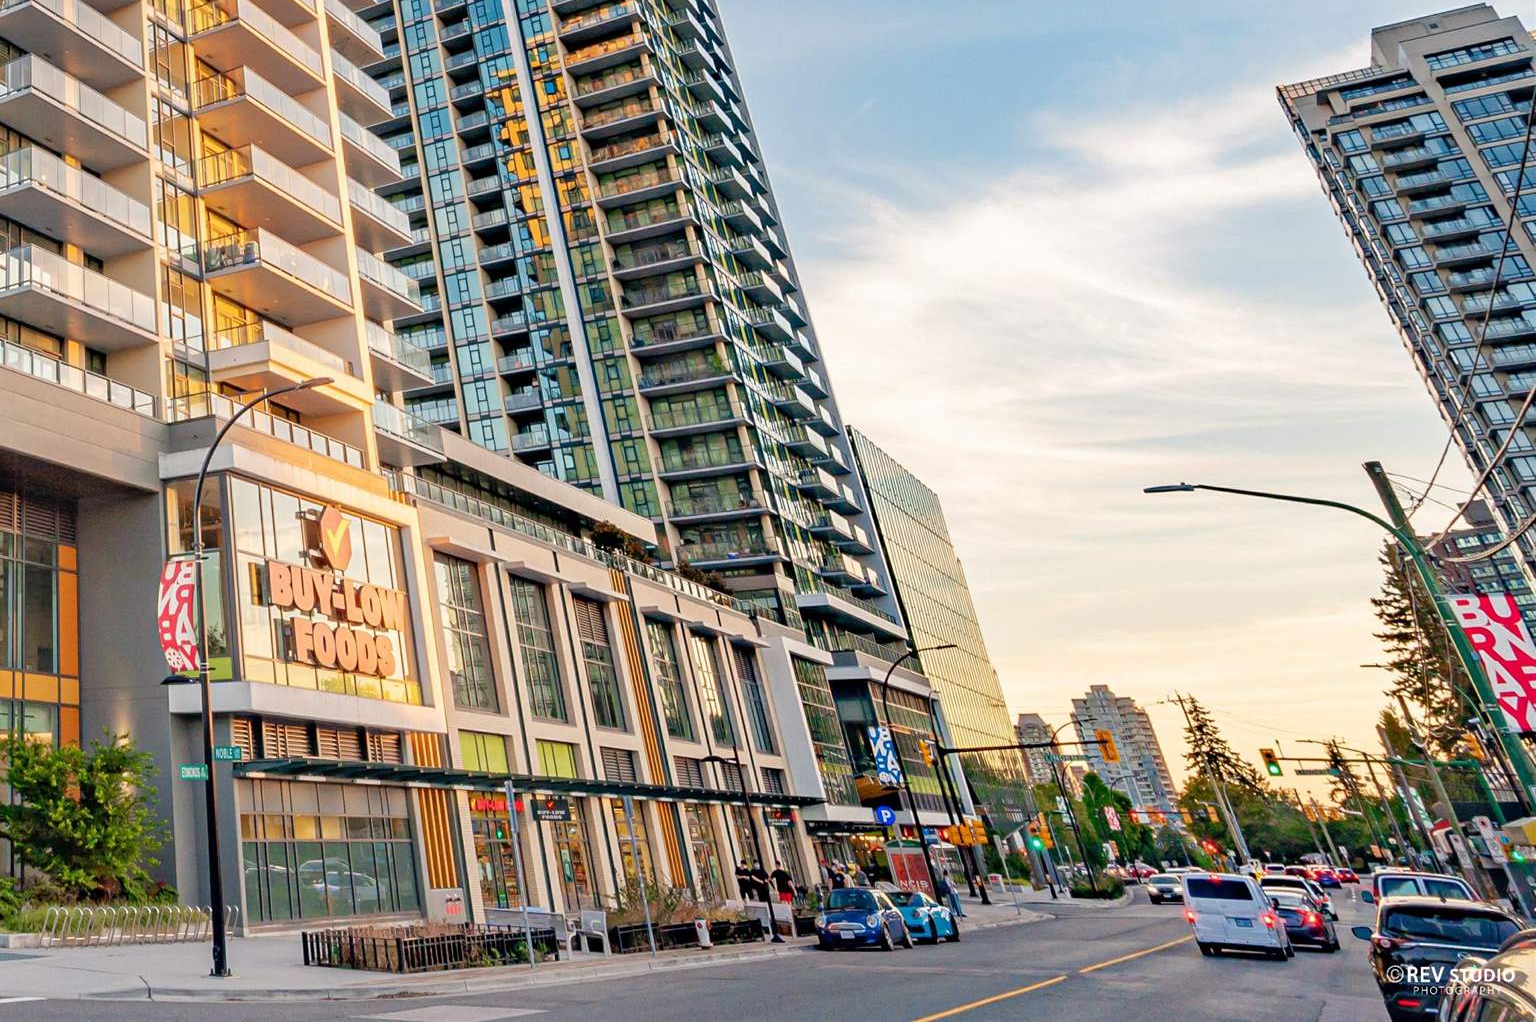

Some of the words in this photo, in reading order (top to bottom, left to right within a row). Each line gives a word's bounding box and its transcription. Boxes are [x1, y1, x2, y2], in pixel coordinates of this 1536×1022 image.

[268, 560, 407, 631] BUY-LOW
[293, 618, 396, 677] FOODS
[215, 748, 233, 759] NOBLE
[880, 809, 891, 823] P
[900, 880, 928, 889] NCIS
